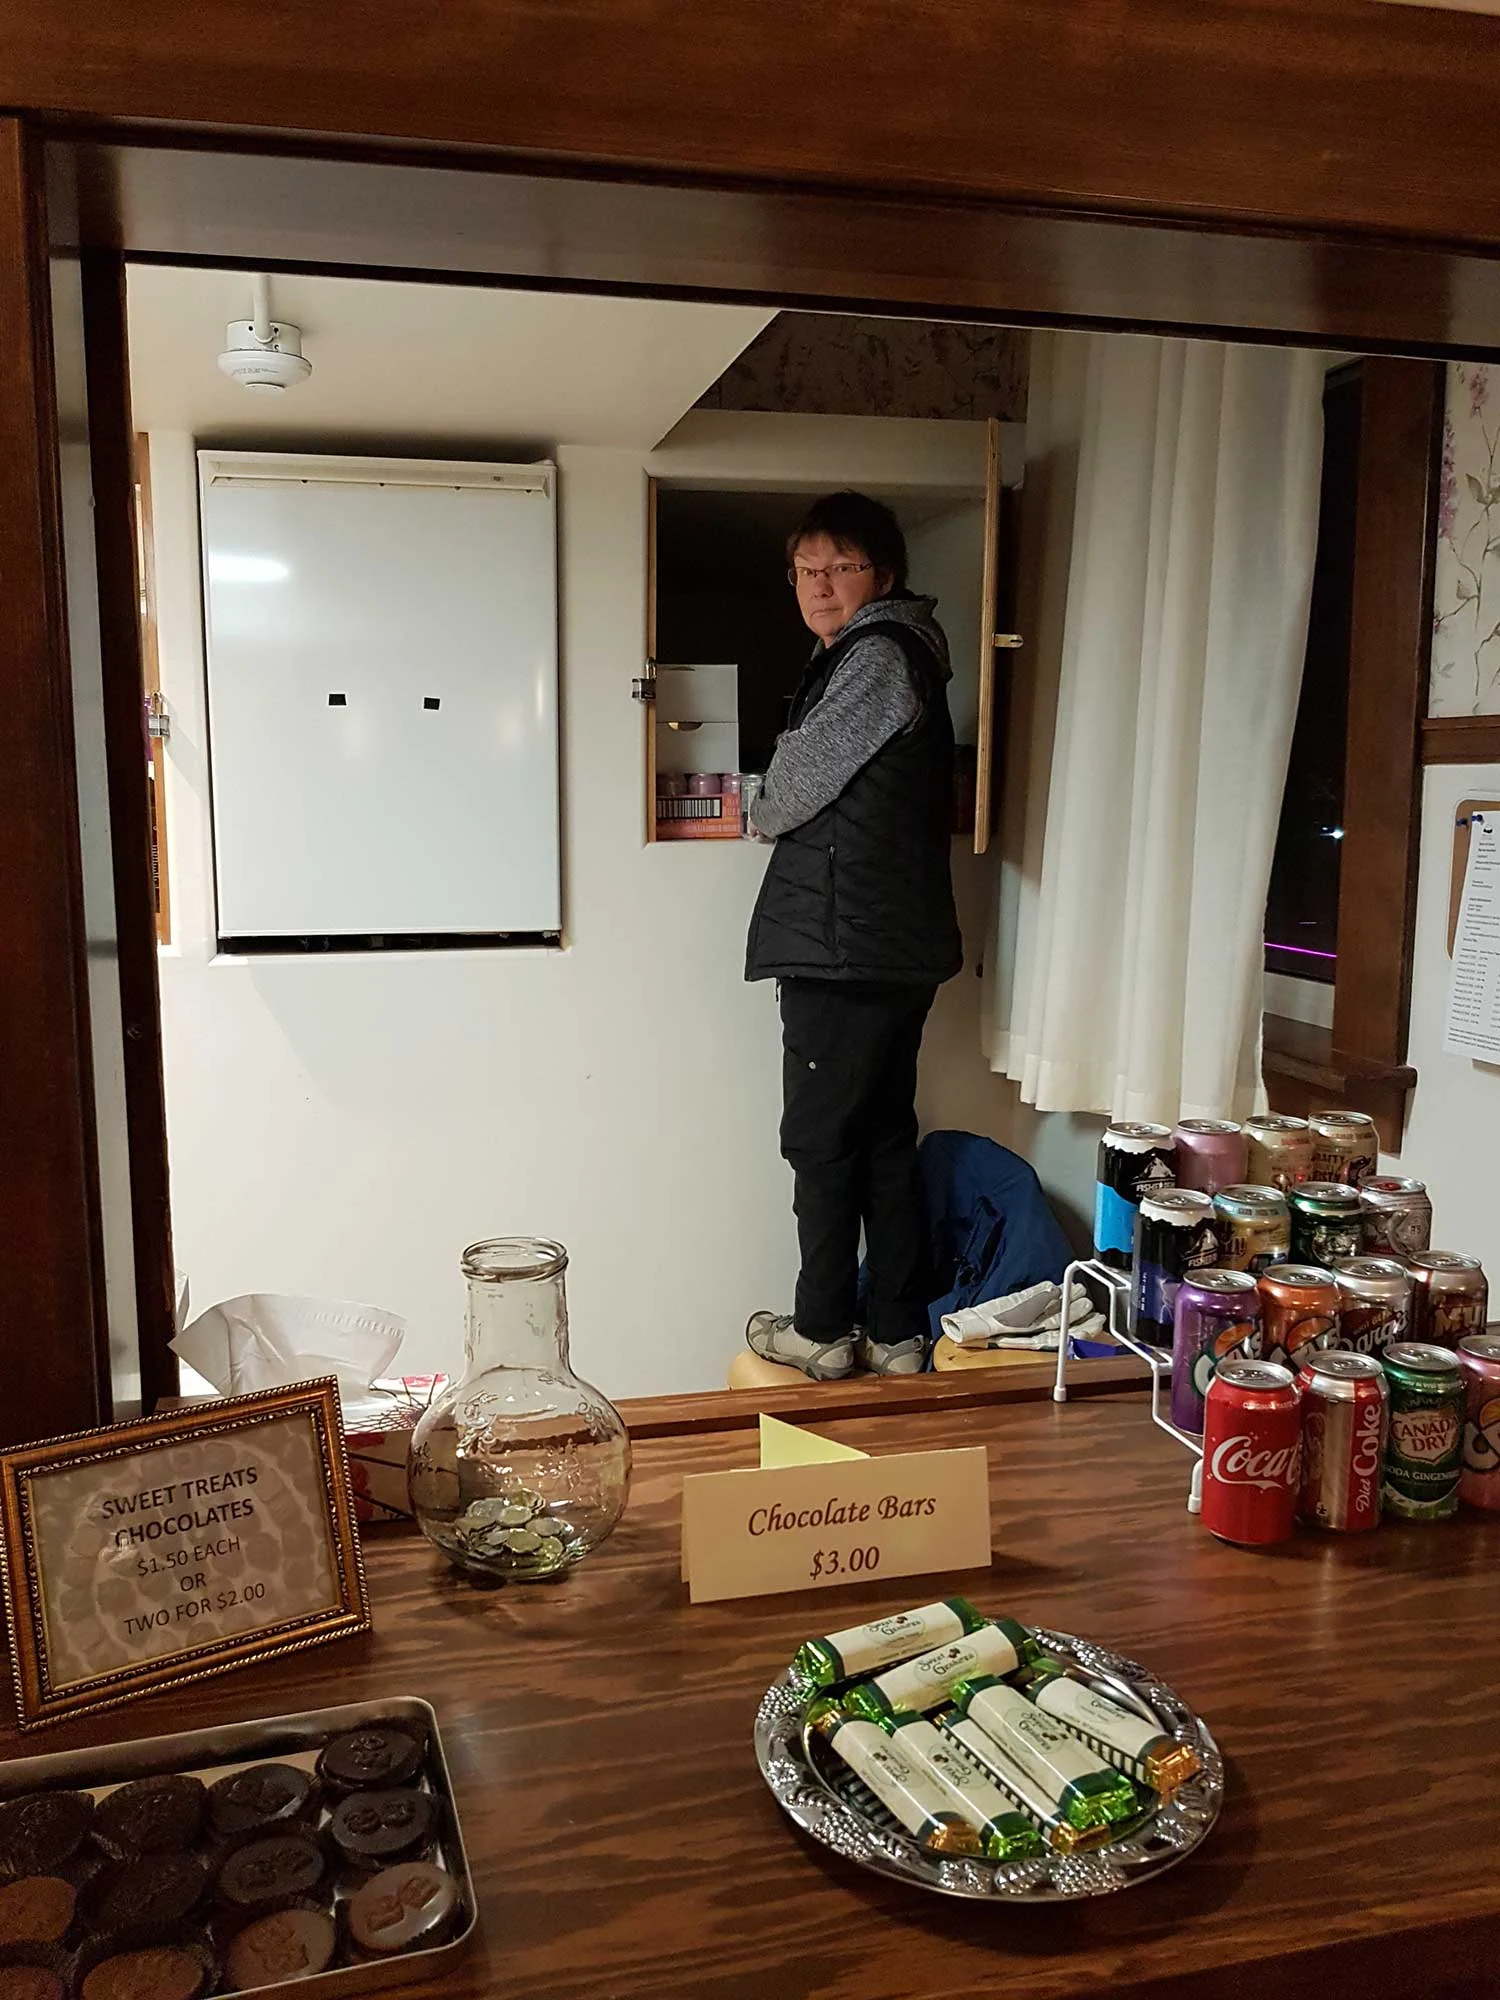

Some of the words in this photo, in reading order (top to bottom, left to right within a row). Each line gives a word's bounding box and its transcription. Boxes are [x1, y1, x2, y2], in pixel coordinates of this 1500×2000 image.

[1352, 1404, 1381, 1477] Coke
[1411, 1433, 1448, 1452] DRY
[102, 1485, 177, 1519] SWEET
[181, 1466, 258, 1499] TREATS
[1355, 1478, 1371, 1512] Diet
[114, 1498, 254, 1548] CHOCOLATES
[748, 1498, 871, 1536] Chocolate
[877, 1494, 937, 1520] Bars
[137, 1550, 188, 1577] $1.50
[194, 1535, 241, 1562] EACH
[809, 1545, 880, 1580] $3.00
[180, 1572, 207, 1592] OR
[124, 1609, 170, 1635] TWO
[176, 1598, 212, 1621] FOR
[216, 1582, 265, 1610] $2.00
